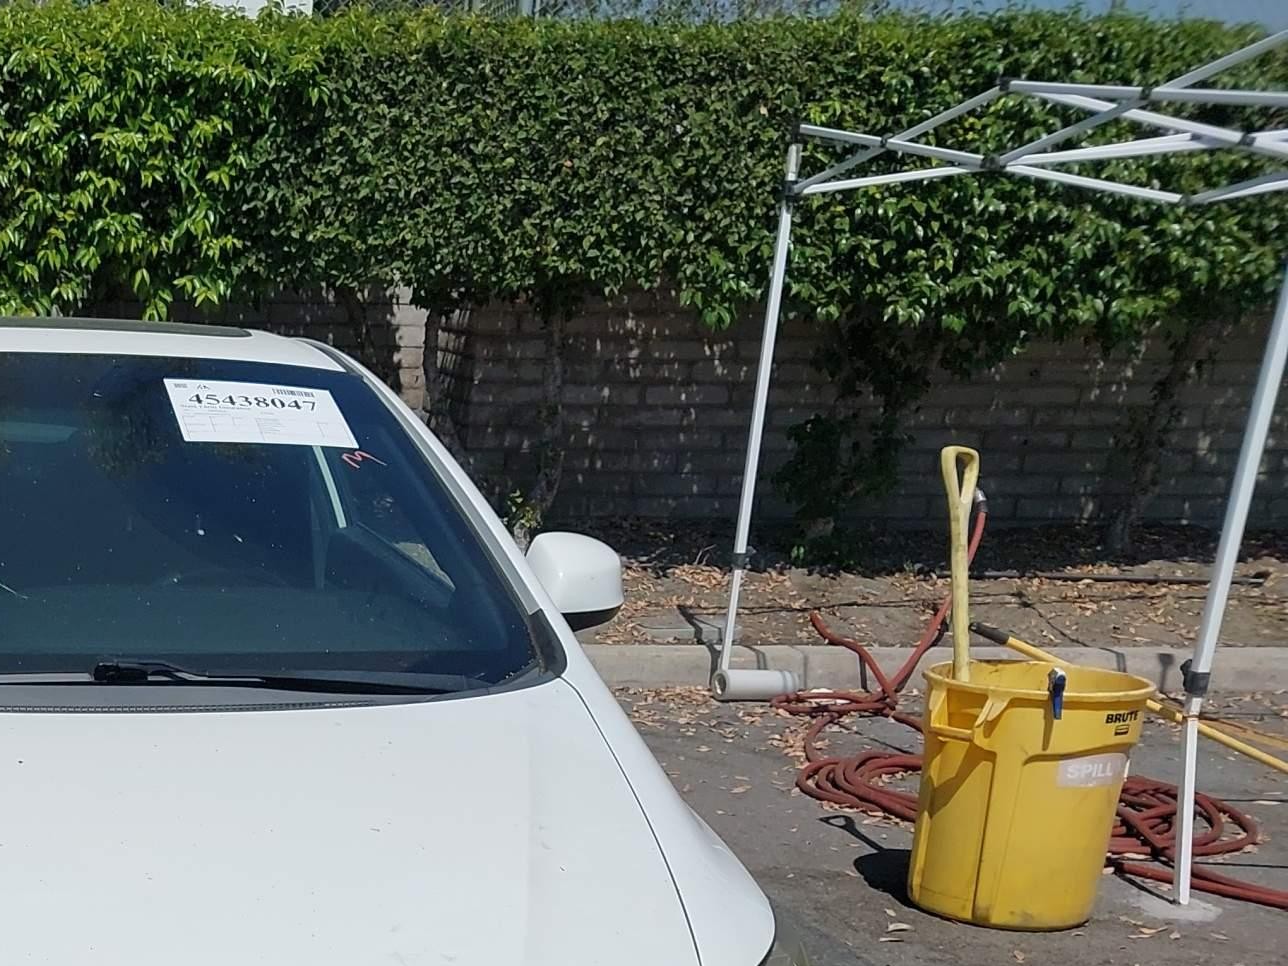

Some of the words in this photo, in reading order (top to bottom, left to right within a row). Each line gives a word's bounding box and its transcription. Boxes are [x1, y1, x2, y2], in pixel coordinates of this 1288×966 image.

[188, 393, 316, 411] 45438047
[1105, 710, 1140, 724] BRUTE
[1066, 761, 1113, 778] SPILL
